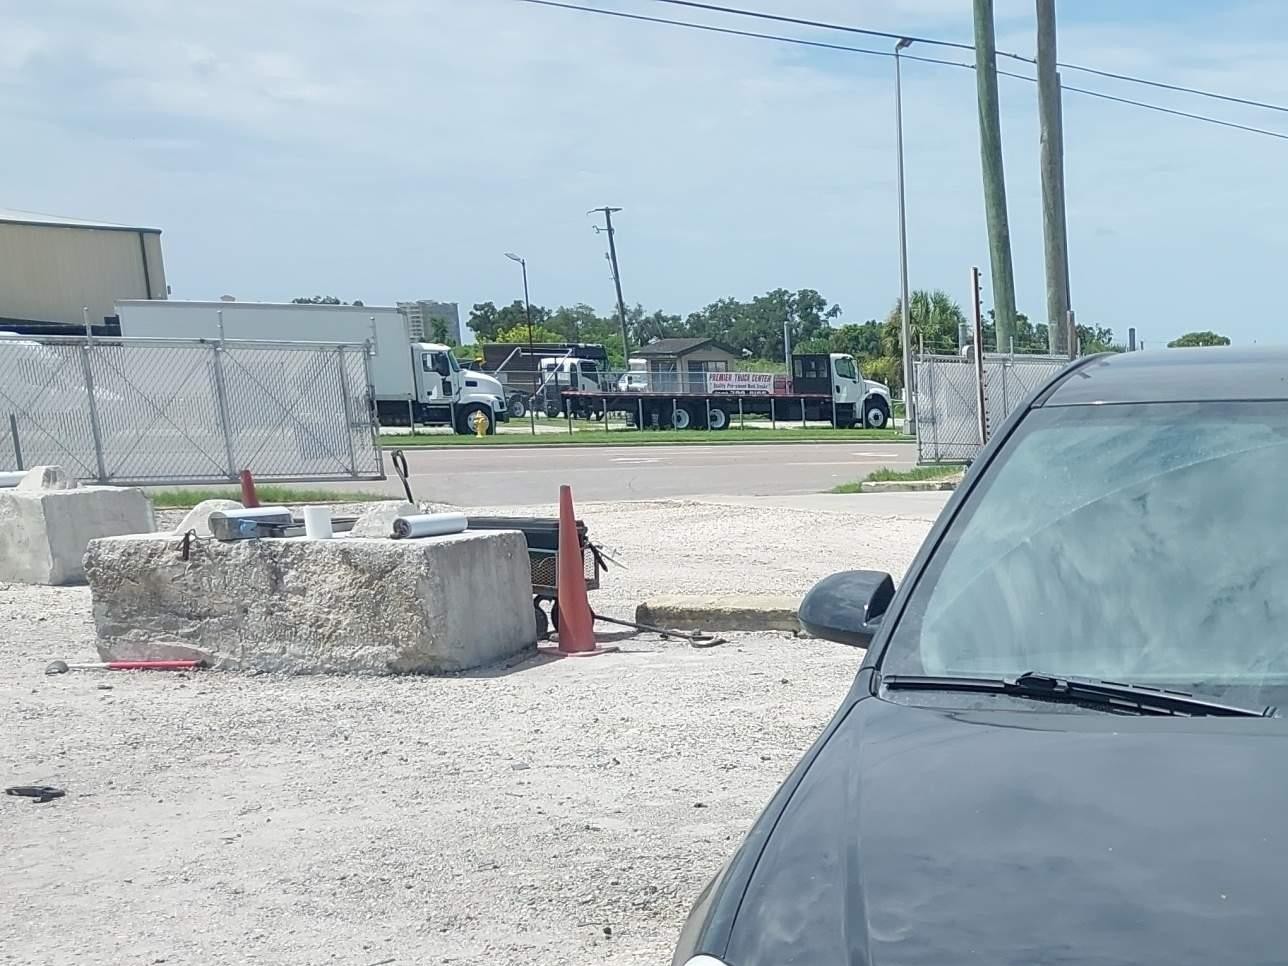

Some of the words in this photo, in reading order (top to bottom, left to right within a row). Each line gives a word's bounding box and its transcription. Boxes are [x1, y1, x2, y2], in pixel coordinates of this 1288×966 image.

[710, 374, 732, 382] PREMIER
[735, 374, 750, 382] TRUCK
[752, 374, 771, 383] CENTER
